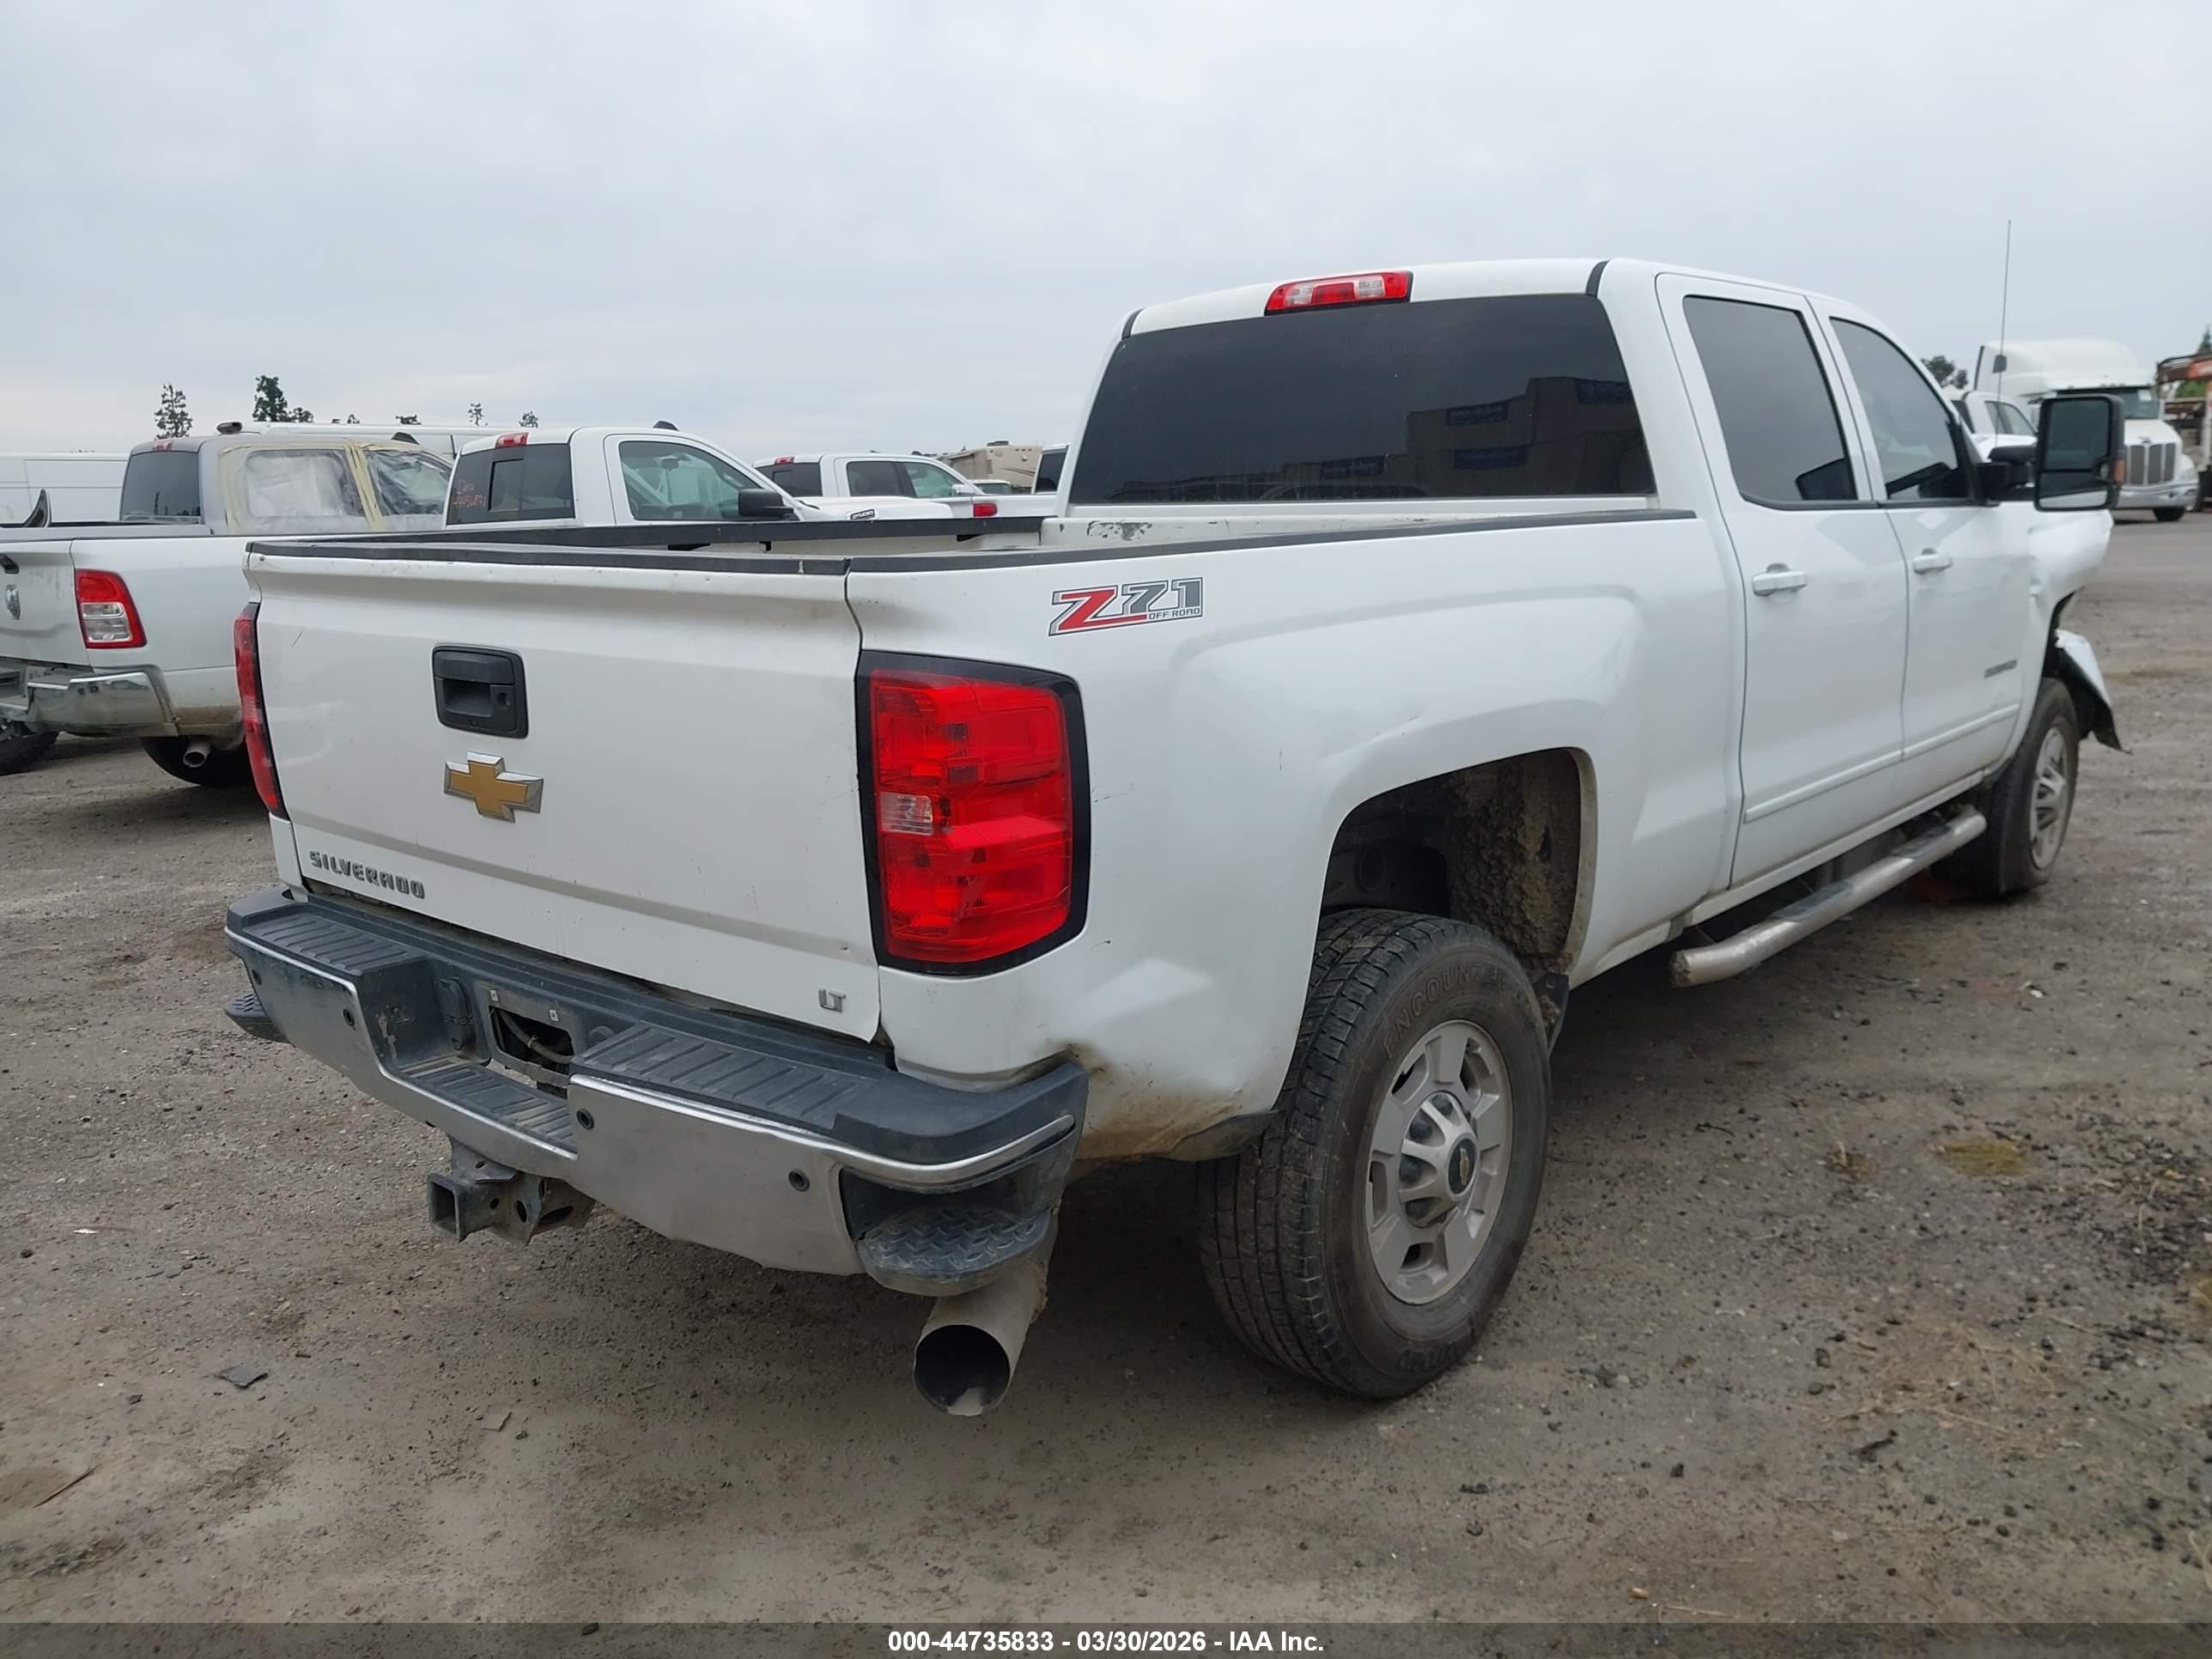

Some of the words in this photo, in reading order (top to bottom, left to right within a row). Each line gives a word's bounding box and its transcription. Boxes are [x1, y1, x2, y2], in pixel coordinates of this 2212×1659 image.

[1048, 577, 1203, 636] Z71
[1148, 611, 1170, 621] OFF
[1171, 607, 1200, 617] ROAD
[309, 850, 426, 900] SILVERADO
[818, 988, 846, 1013] LT
